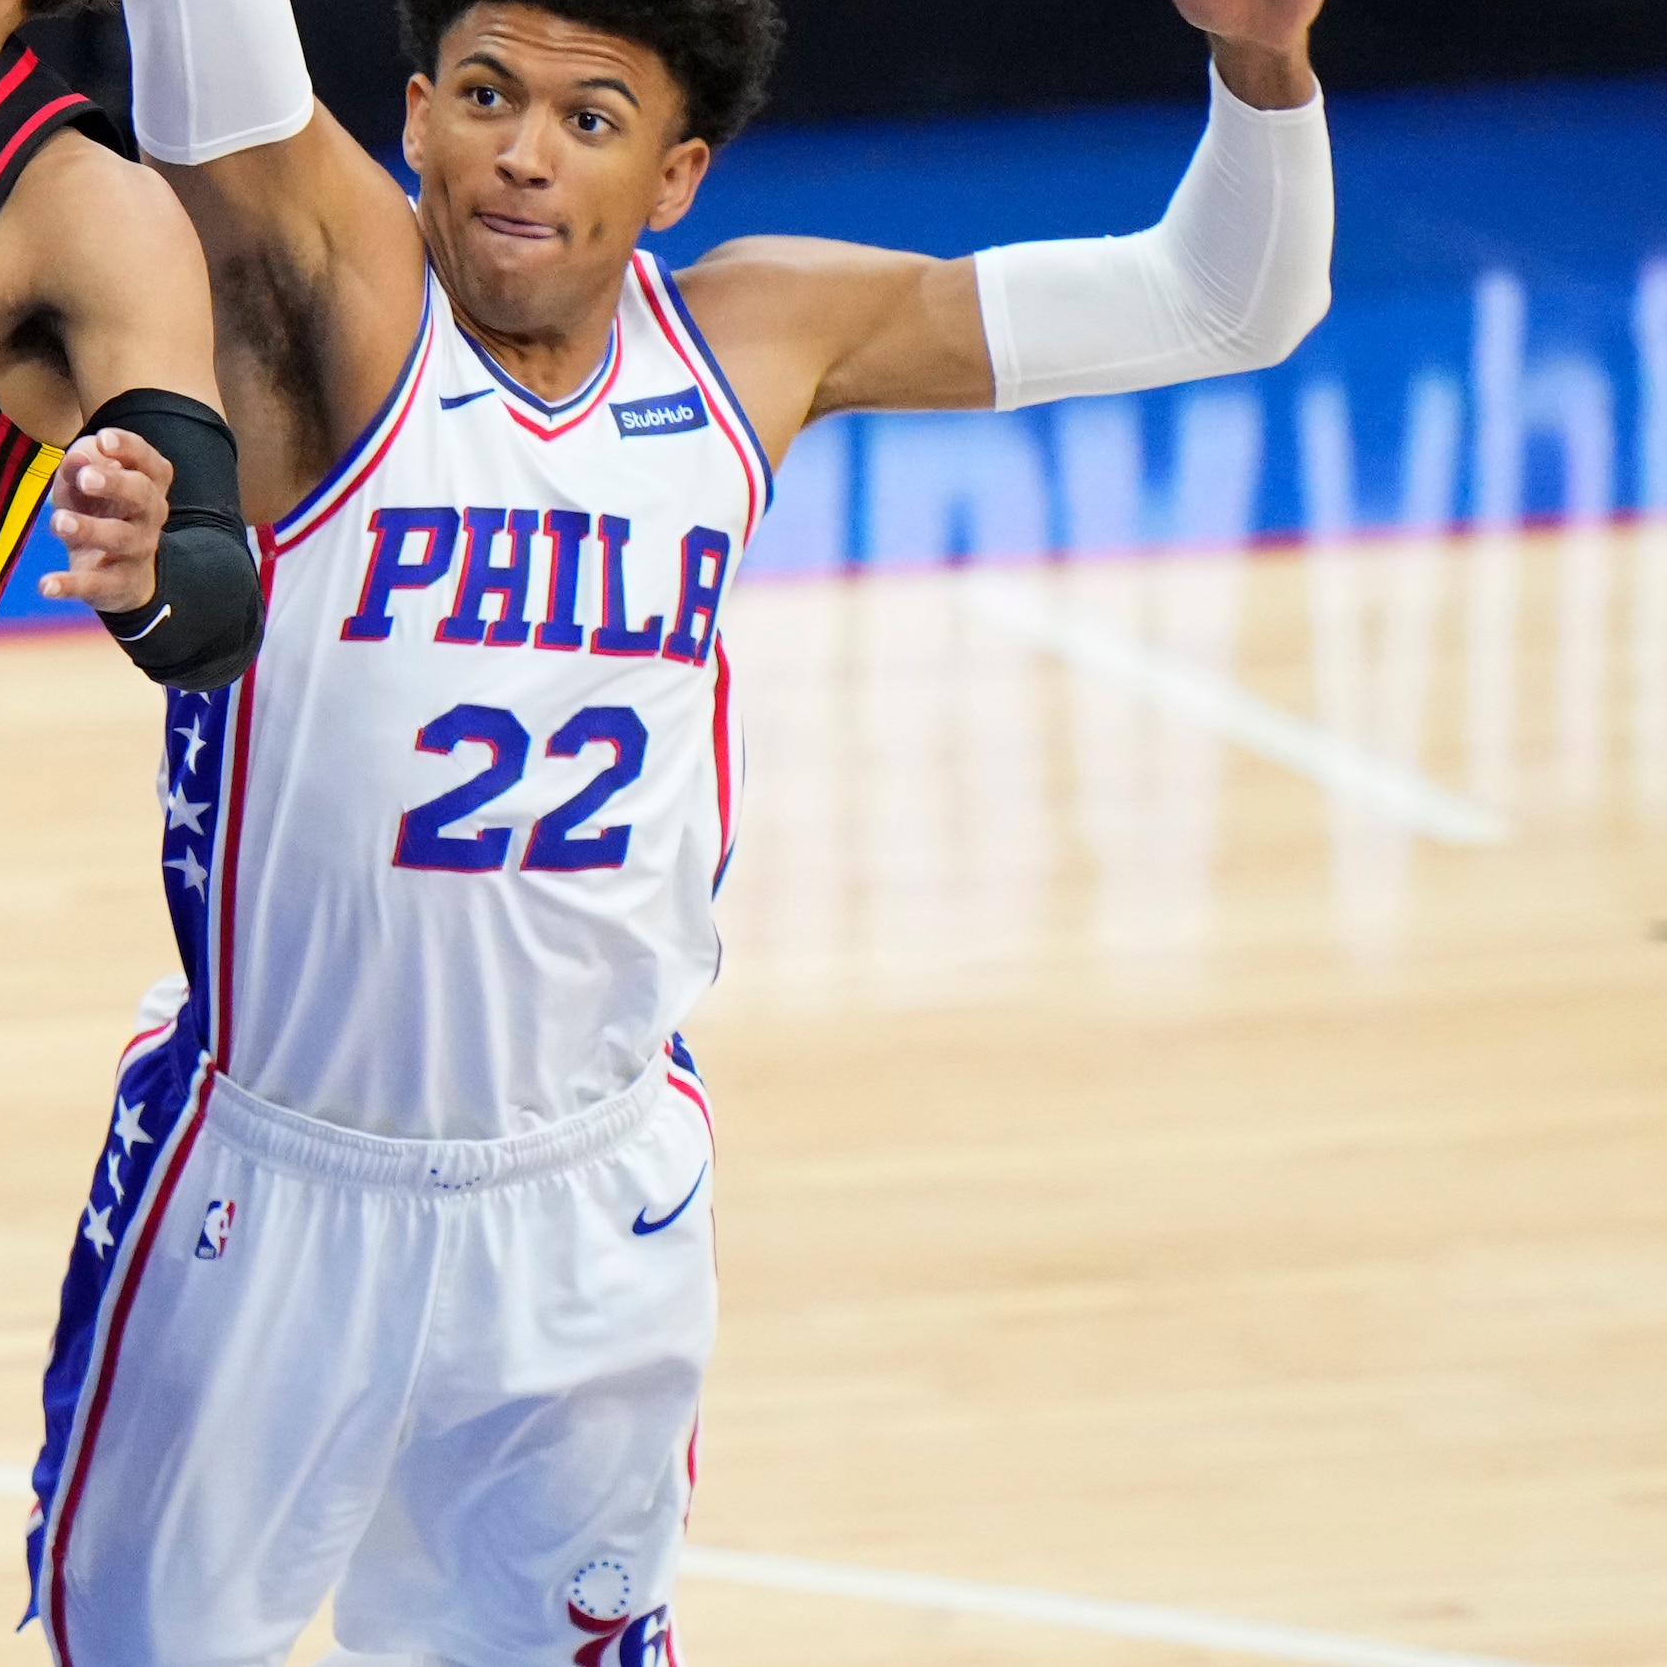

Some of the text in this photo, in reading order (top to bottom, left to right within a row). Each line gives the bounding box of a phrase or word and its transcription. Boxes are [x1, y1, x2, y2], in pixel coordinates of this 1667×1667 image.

[620, 404, 695, 430] StubHub
[339, 506, 731, 669] PHILA
[392, 703, 649, 874] 22
